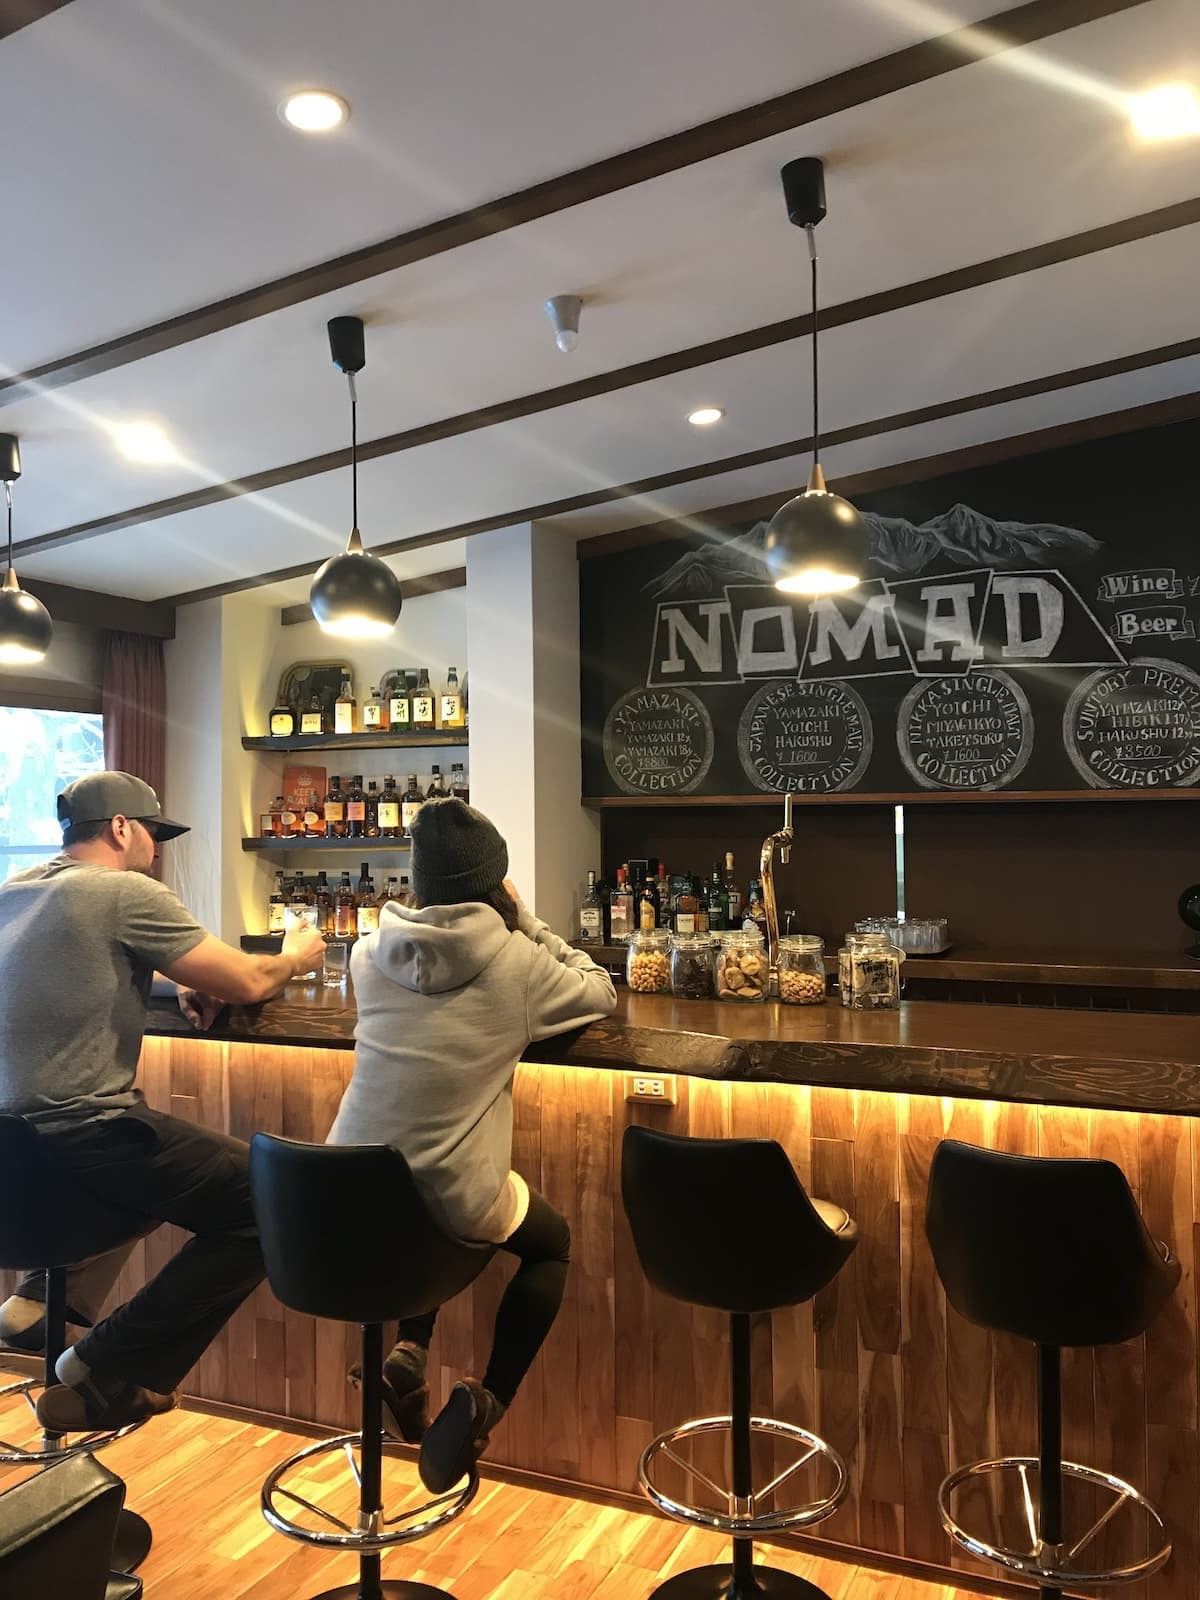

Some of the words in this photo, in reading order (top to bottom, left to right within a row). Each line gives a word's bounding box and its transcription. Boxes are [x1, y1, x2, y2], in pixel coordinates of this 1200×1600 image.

[1107, 575, 1169, 595] Wine
[660, 575, 1064, 673] NOMAD
[1119, 613, 1177, 635] Beer
[614, 693, 699, 725] YAMAZAKI
[798, 682, 856, 715] SINGLE
[932, 698, 991, 717] YOICHI
[1077, 669, 1132, 741] SUNTORY
[773, 704, 840, 719] YAMAZAKI
[909, 690, 942, 744] NIKKA
[941, 677, 1009, 703] SINGLE
[1002, 702, 1021, 739] MALT
[1111, 713, 1169, 728] HIBIKI
[628, 718, 685, 732] YAMAZAKI
[781, 720, 829, 734] YOICHI
[926, 717, 1002, 733] MIYAGIKYO
[1098, 728, 1169, 743] HAKUSHU
[775, 735, 832, 749] HAKUSHU
[926, 732, 1003, 748] TAKETSURU
[614, 752, 702, 790] COLLECTION
[754, 756, 855, 791] COLLECTION
[916, 747, 1017, 786] COLLECTION
[1090, 745, 1200, 786] COLLECTION
